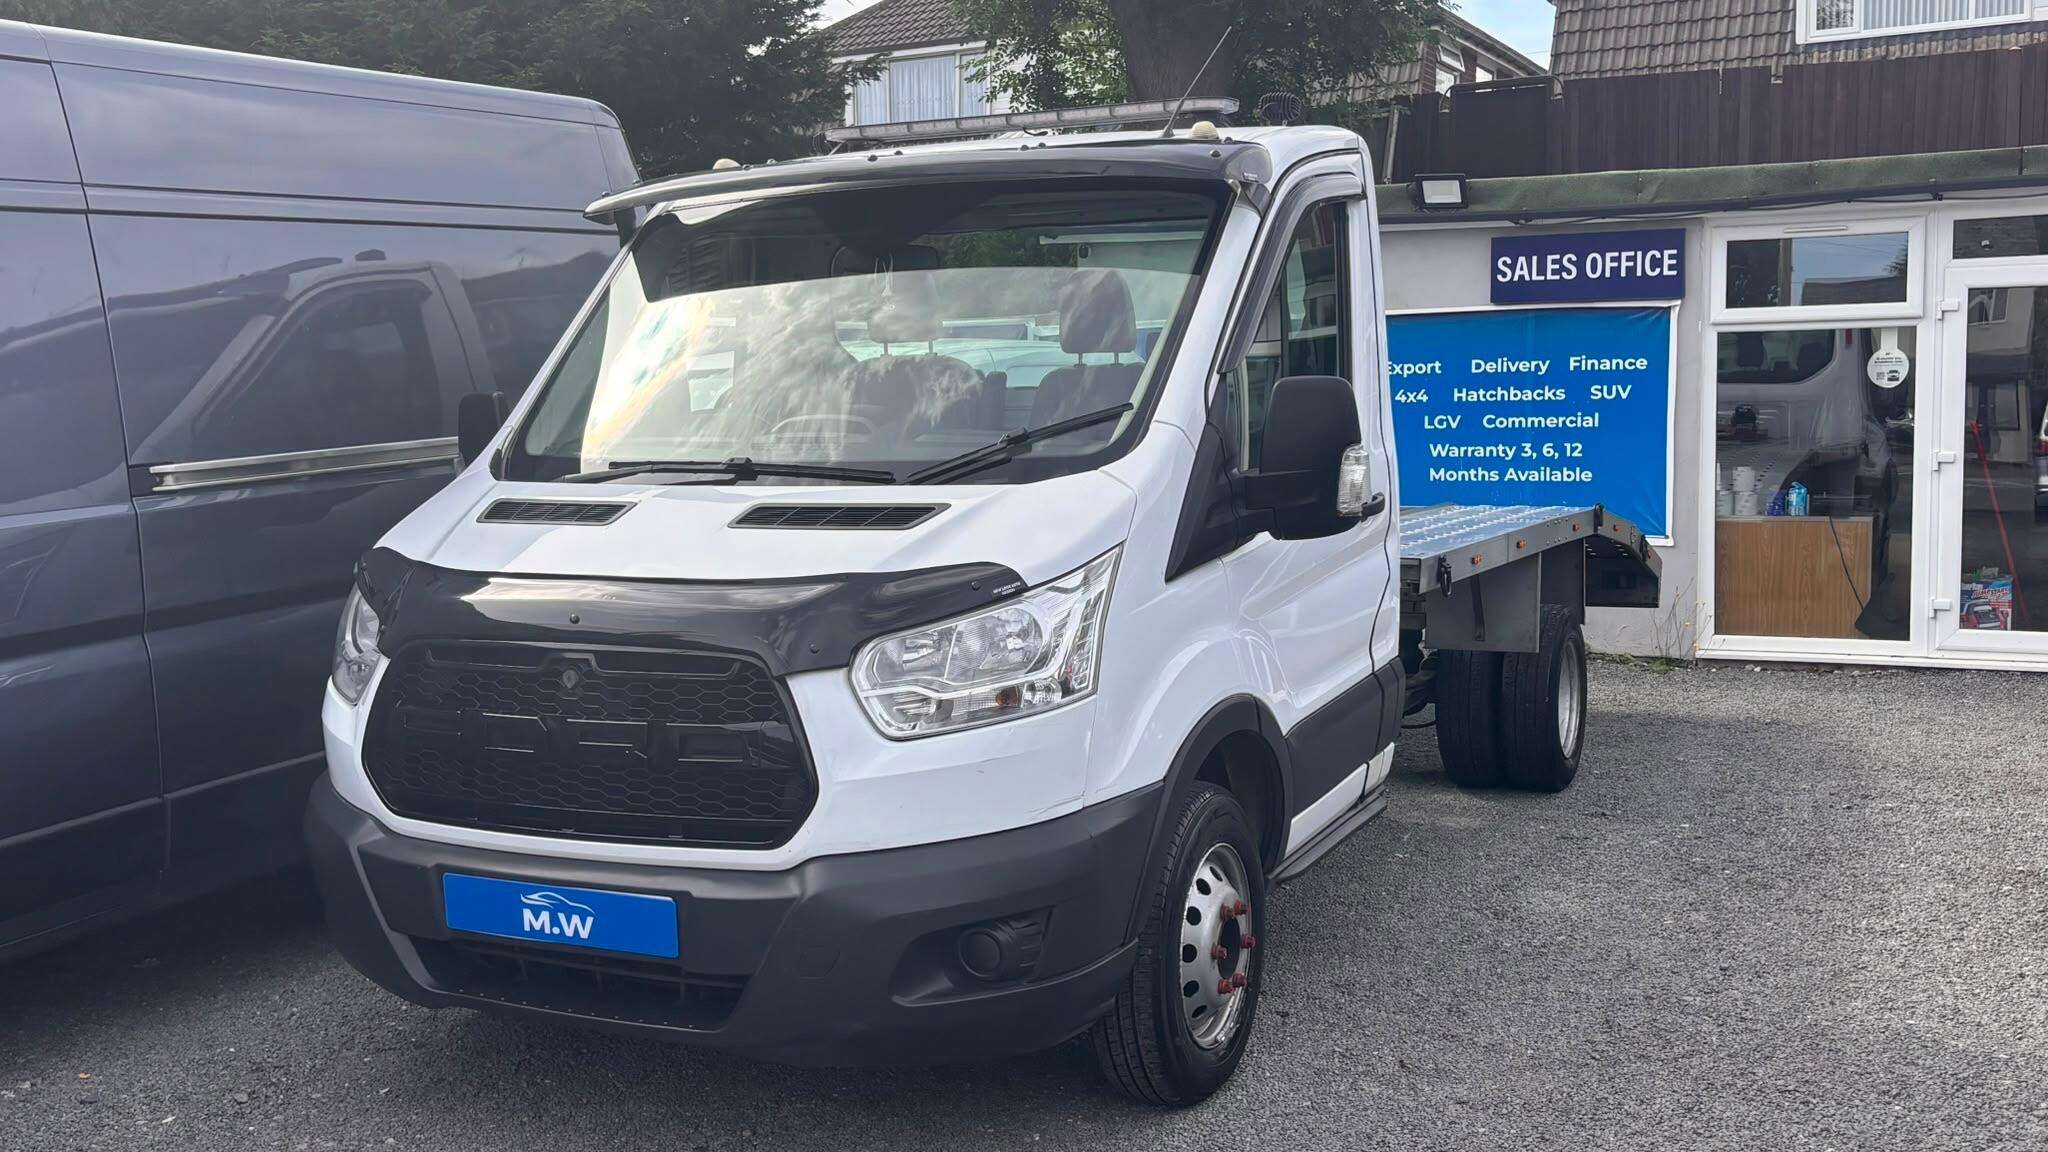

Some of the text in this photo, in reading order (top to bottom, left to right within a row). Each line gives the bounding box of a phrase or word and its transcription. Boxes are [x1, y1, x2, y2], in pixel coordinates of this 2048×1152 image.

[1496, 249, 1678, 282] SALES OFFICE
[1470, 357, 1551, 376] Delivery
[1569, 355, 1648, 372] Finance
[1394, 384, 1632, 403] 4x4 Hatchbacks SUV
[1424, 412, 1599, 429] LGV Commercial
[1429, 442, 1583, 461] Warranty 3, 6, 12
[1429, 467, 1593, 482] Months Available
[522, 908, 594, 939] M.W
